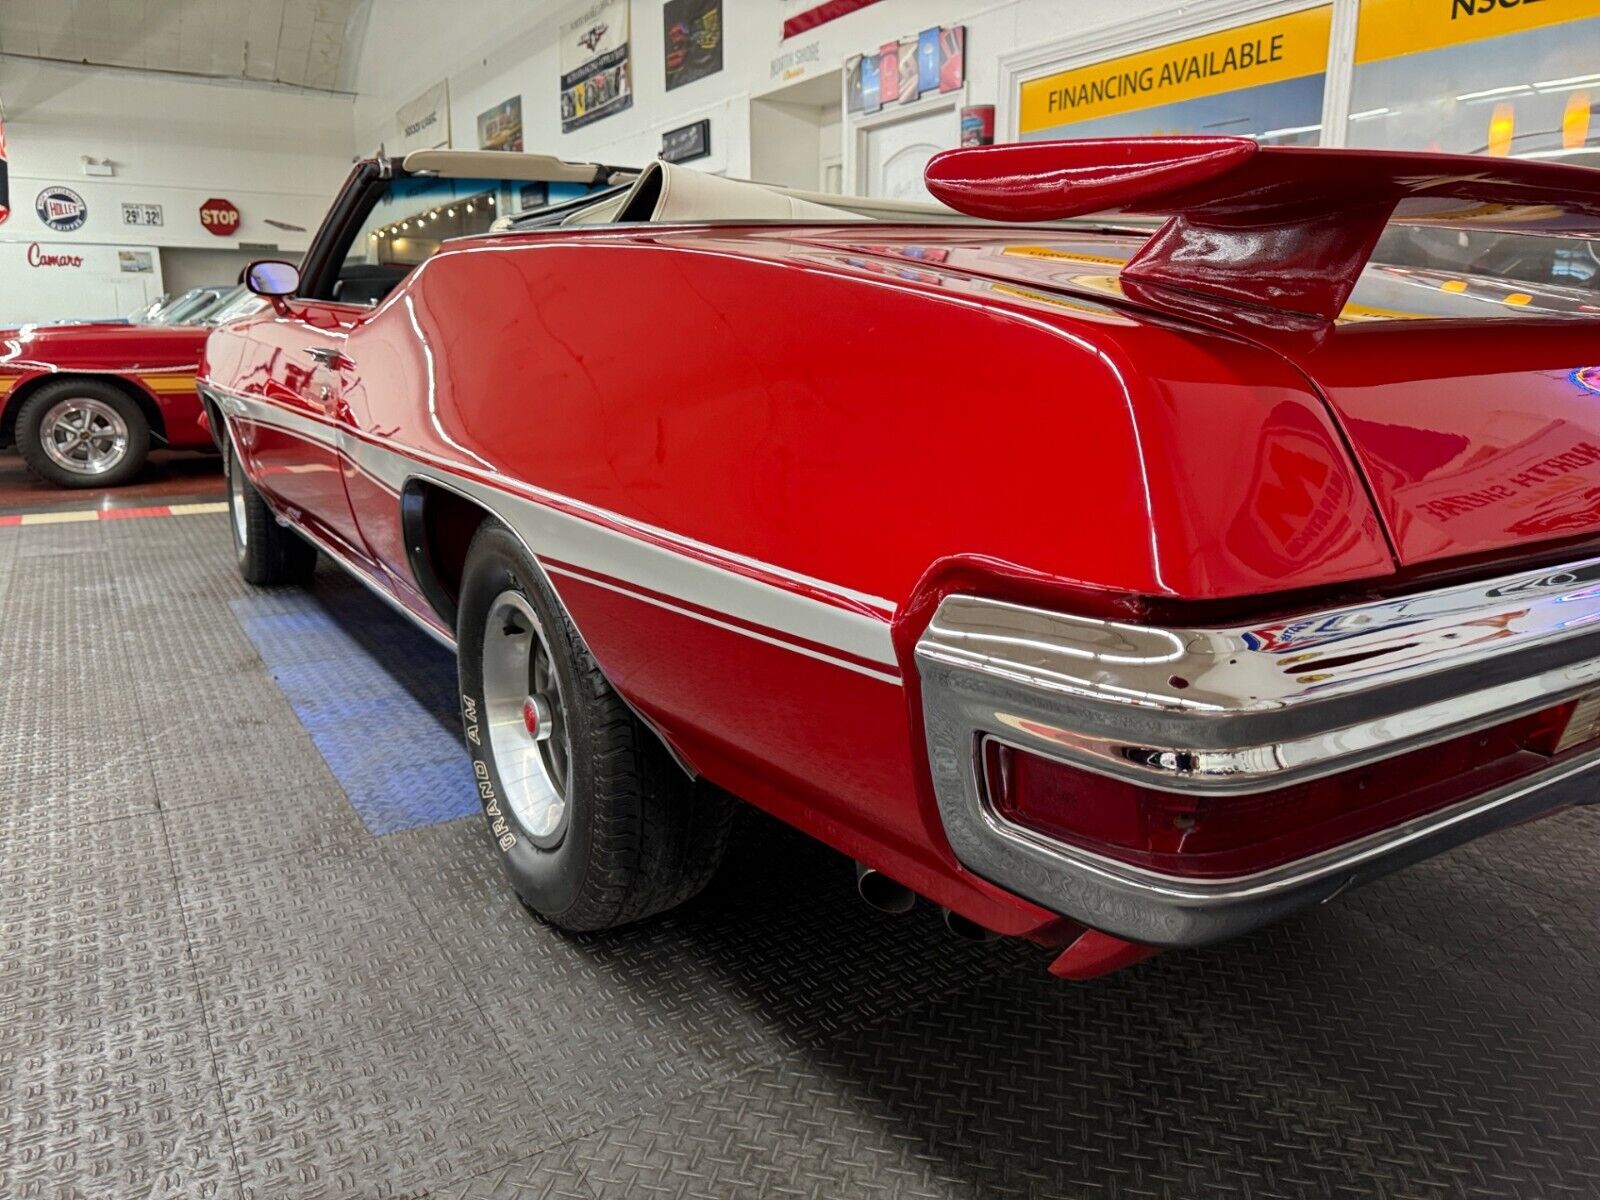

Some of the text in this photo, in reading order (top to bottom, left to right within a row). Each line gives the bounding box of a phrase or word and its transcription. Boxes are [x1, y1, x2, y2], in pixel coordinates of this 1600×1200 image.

[1048, 34, 1284, 113] FINANCING AVAILABLE
[50, 201, 78, 217] HOLLEY
[201, 209, 238, 225] STOP
[27, 242, 84, 268] Camaro
[462, 694, 517, 852] GRAND AM
